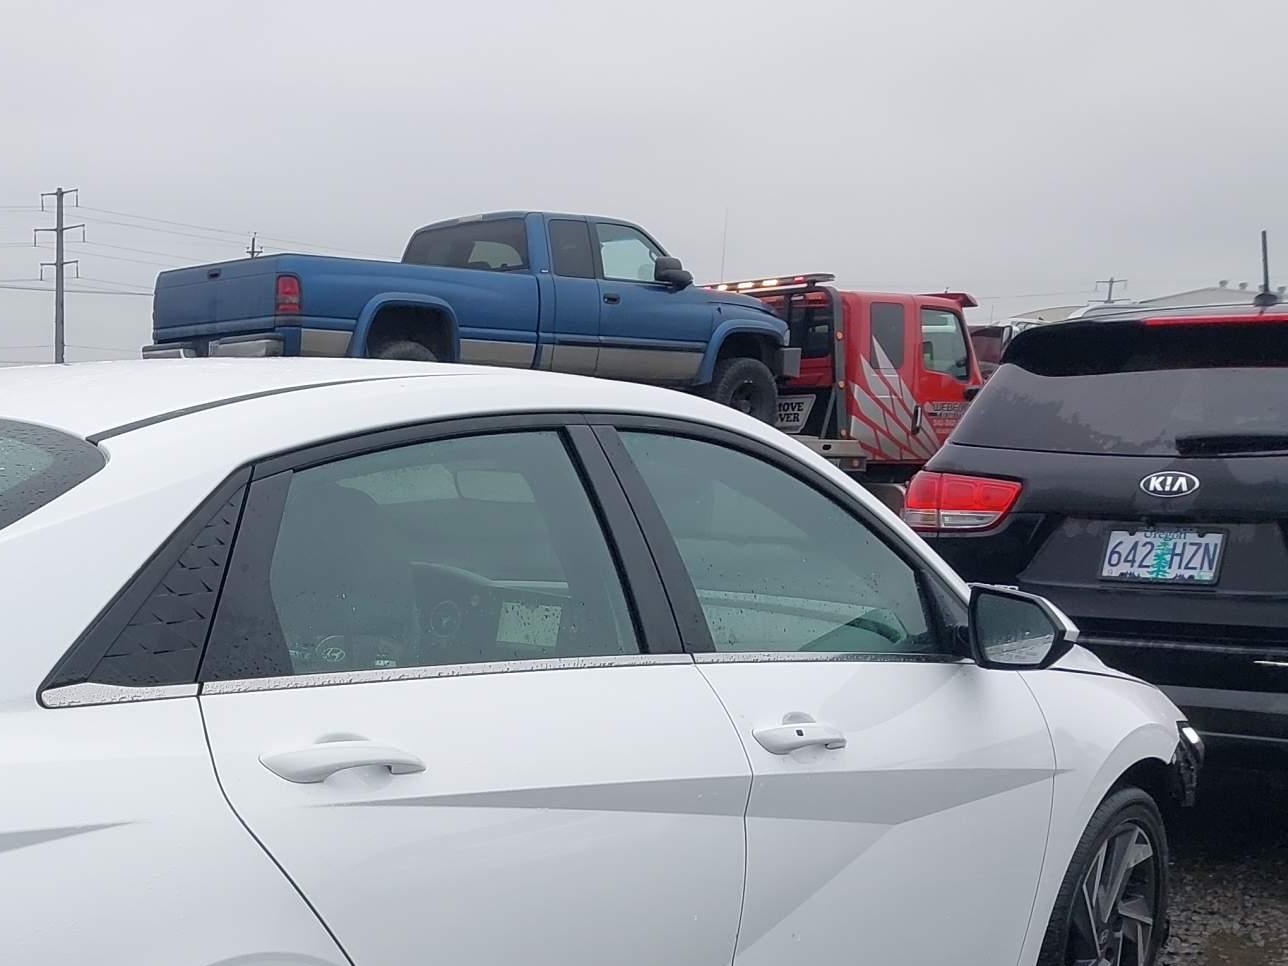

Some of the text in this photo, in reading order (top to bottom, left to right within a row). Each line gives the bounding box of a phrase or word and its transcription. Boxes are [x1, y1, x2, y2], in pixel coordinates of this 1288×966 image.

[776, 413, 800, 422] VER
[1149, 476, 1188, 491] KIA
[1107, 541, 1218, 571] 642 HZN
